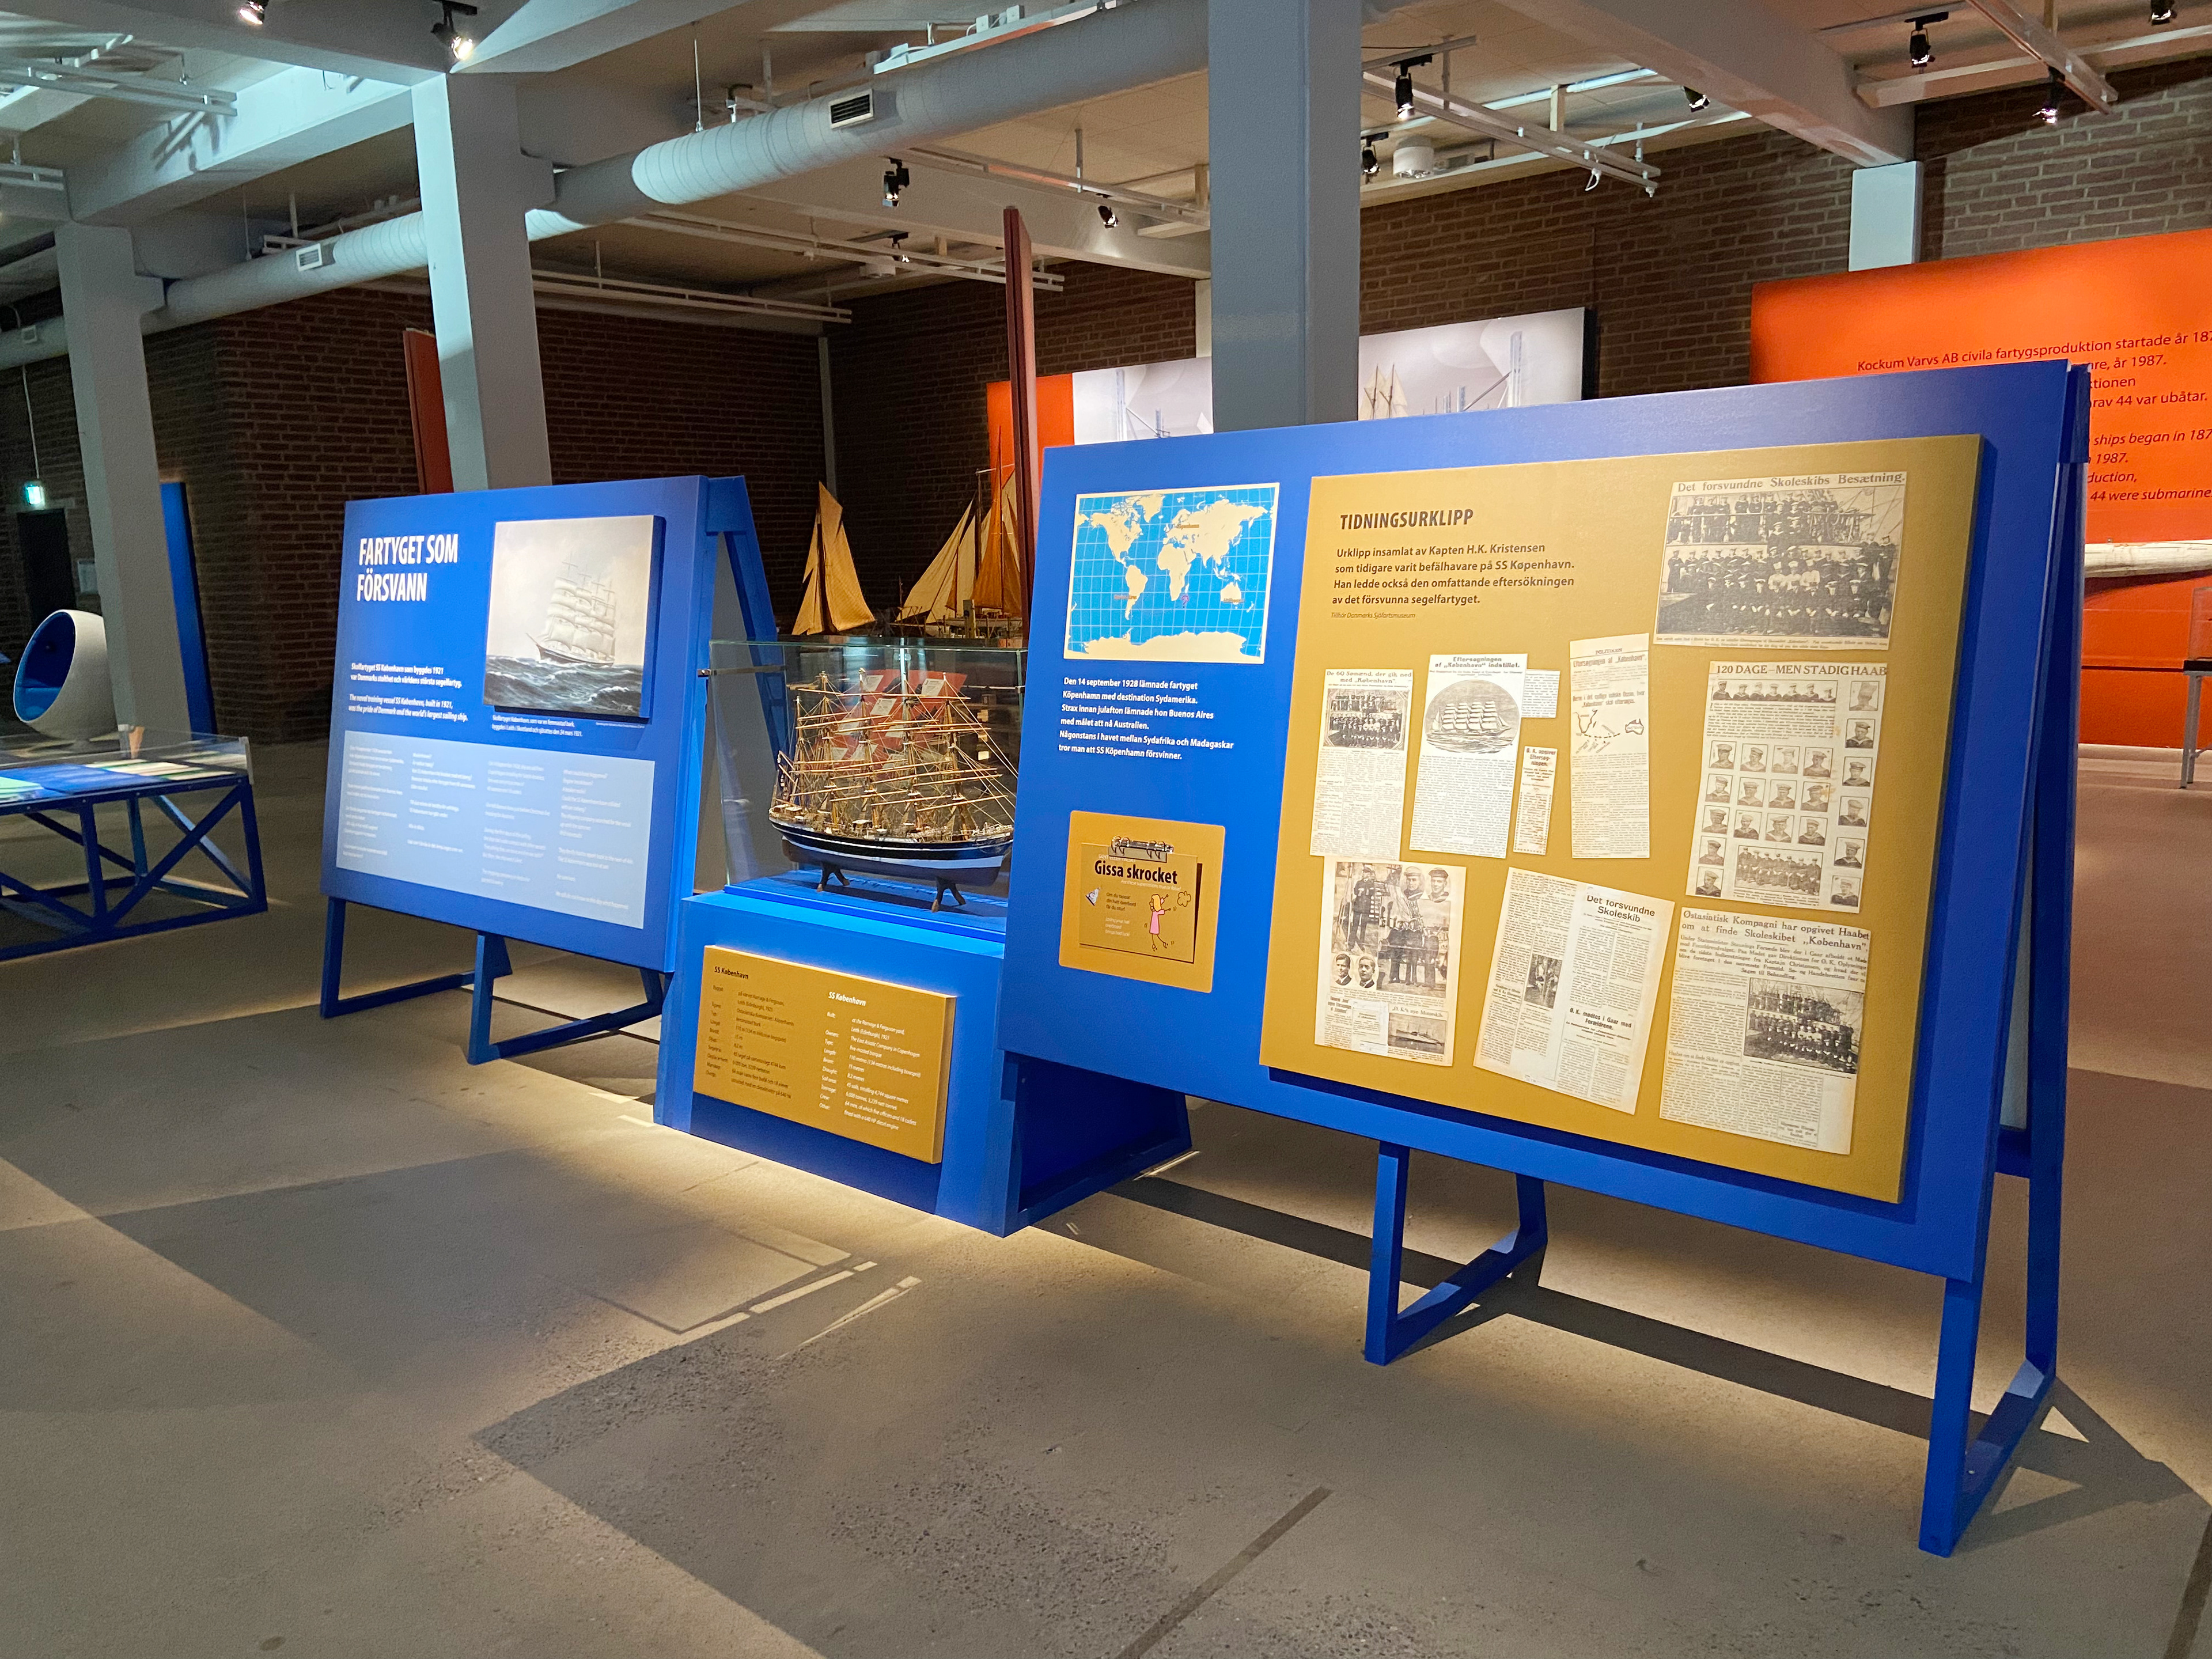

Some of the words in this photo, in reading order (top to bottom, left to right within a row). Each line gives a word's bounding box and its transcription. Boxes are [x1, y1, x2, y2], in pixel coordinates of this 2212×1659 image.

[1858, 359, 1904, 371] Kockum
[1907, 356, 1938, 367] Varvs
[1942, 353, 1959, 363] AB
[1961, 350, 1992, 362] civila
[1996, 341, 2111, 358] fartygsproduktion
[2116, 335, 2171, 349] startade
[2175, 333, 2188, 344] år
[2113, 357, 2126, 369] år
[2132, 354, 2166, 366] 1987.
[2116, 396, 2133, 406] 44
[2137, 395, 2157, 404] var
[2161, 391, 2207, 403] ubåtar.
[2094, 434, 2126, 447] ships
[2129, 434, 2169, 445] began
[2173, 431, 2185, 441] in
[2097, 453, 2128, 464] 1987.
[1678, 483, 1695, 492] Det
[1703, 480, 1763, 491] forsvundne
[1770, 476, 1830, 487] Skoleskibs
[1838, 473, 1905, 484] Besætning.
[2090, 491, 2105, 501] 44
[2109, 493, 2139, 501] were
[2141, 488, 2212, 500] submarine
[1340, 509, 1474, 529] TIDNINGSURKLIPP
[359, 536, 425, 566] FARTYGET
[426, 534, 459, 564] SOM
[1337, 548, 1370, 559] Urklipp
[1373, 547, 1413, 557] insamlat
[1429, 545, 1464, 558] Kapten
[1467, 544, 1487, 554] H.K.
[1490, 544, 1545, 554] Kristensen
[1356, 563, 1392, 574] tidigare
[1395, 563, 1416, 571] varit
[1419, 561, 1478, 571] befälhavare
[1480, 560, 1493, 572] på
[1495, 560, 1508, 570] SS
[1510, 559, 1575, 571] Køpenhavn.
[357, 567, 427, 601] FÖRSVANN
[1334, 579, 1351, 589] Han
[1354, 579, 1380, 588] ledde
[1382, 578, 1408, 588] också
[1411, 578, 1429, 587] den
[1431, 577, 1490, 587] omfattande
[1493, 577, 1574, 588] eftersökningen
[1345, 595, 1360, 604] det
[1362, 594, 1409, 604] försvunna
[1411, 594, 1480, 605] segelfartyget.
[1717, 665, 1733, 673] 120
[1735, 665, 1767, 674] DAGE
[1775, 665, 1802, 674] MEN
[1803, 665, 1849, 675] STADIG
[1851, 666, 1887, 676] HAAB
[1087, 679, 1120, 687] september
[1139, 680, 1168, 689] lämnade
[1169, 681, 1198, 691] fartyget
[1063, 691, 1100, 700] Köpenhamn
[1117, 693, 1154, 702] destination
[1156, 695, 1198, 704] Sydamerika.
[1079, 704, 1097, 713] innan
[1097, 706, 1123, 714] julafton
[1124, 707, 1153, 716] lämnade
[1154, 709, 1167, 717] hon
[1169, 710, 1195, 718] Buenos
[1196, 711, 1214, 719] Aires
[1075, 718, 1094, 726] målet
[1113, 720, 1149, 730] Australien.
[1059, 730, 1096, 740] Någonstans
[1101, 733, 1118, 741] havet
[1143, 736, 1175, 745] Sydafrika
[1176, 738, 1189, 746] och
[1190, 739, 1234, 749] Madagaskar
[1105, 747, 1145, 756] Köpenhamn
[1146, 749, 1182, 760] försvinner.
[1095, 860, 1123, 877] Gissa
[1127, 864, 1177, 884] skrocket
[1587, 895, 1603, 904] Det
[1606, 900, 1655, 916] forsvundne
[1597, 906, 1640, 922] Skoleskib
[1684, 910, 1728, 922] Østasiatisk
[1733, 916, 1777, 928] Kompagni
[1782, 922, 1797, 930] har
[1801, 926, 1835, 934] opgivet
[1839, 927, 1869, 940] Haabet
[1716, 926, 1737, 935] finde
[1745, 929, 1796, 942] Skoleskibet
[721, 968, 748, 979] København
[835, 993, 866, 1006] København
